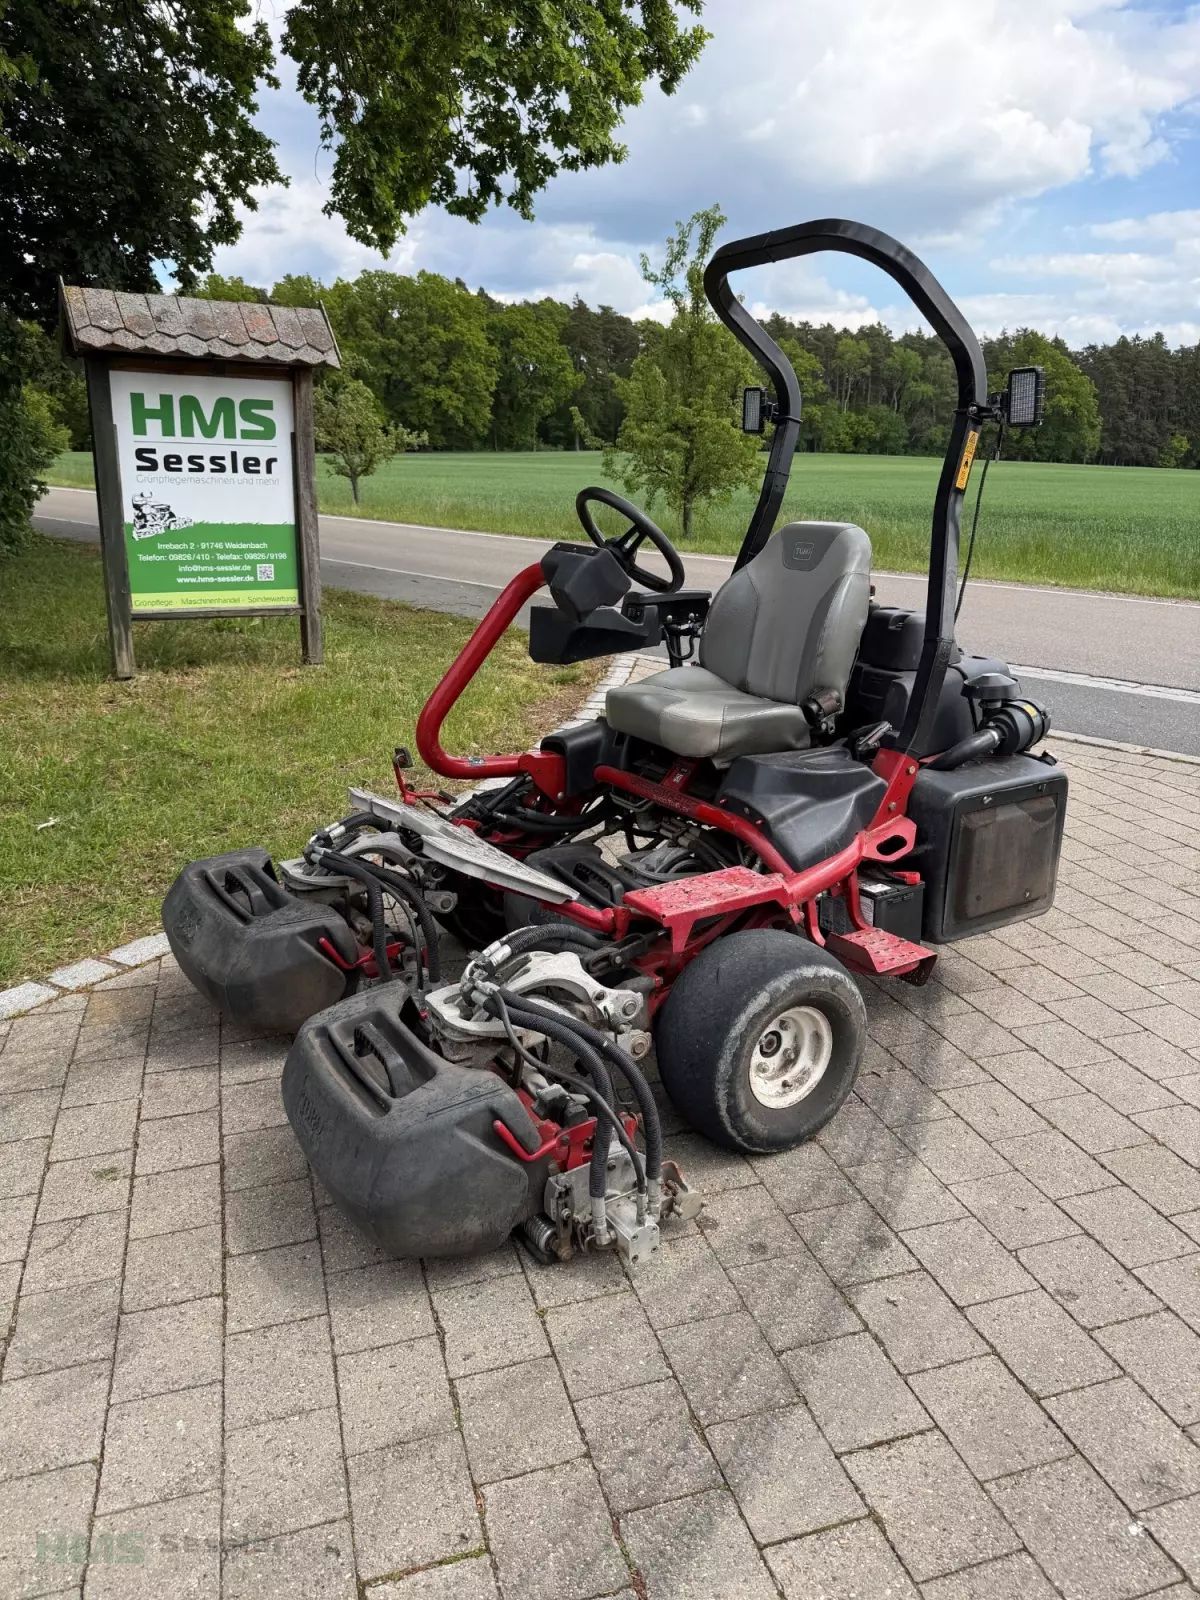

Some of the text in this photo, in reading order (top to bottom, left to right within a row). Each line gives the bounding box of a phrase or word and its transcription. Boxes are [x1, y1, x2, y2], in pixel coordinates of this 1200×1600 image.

[130, 392, 276, 440] HMS
[135, 447, 278, 474] Sessler
[238, 477, 253, 485] und
[225, 541, 268, 549] Weidenbach
[137, 553, 167, 561] Telefon:
[178, 564, 252, 572] info@hms-sessler.de
[176, 575, 254, 583] www.hms-sessler.de
